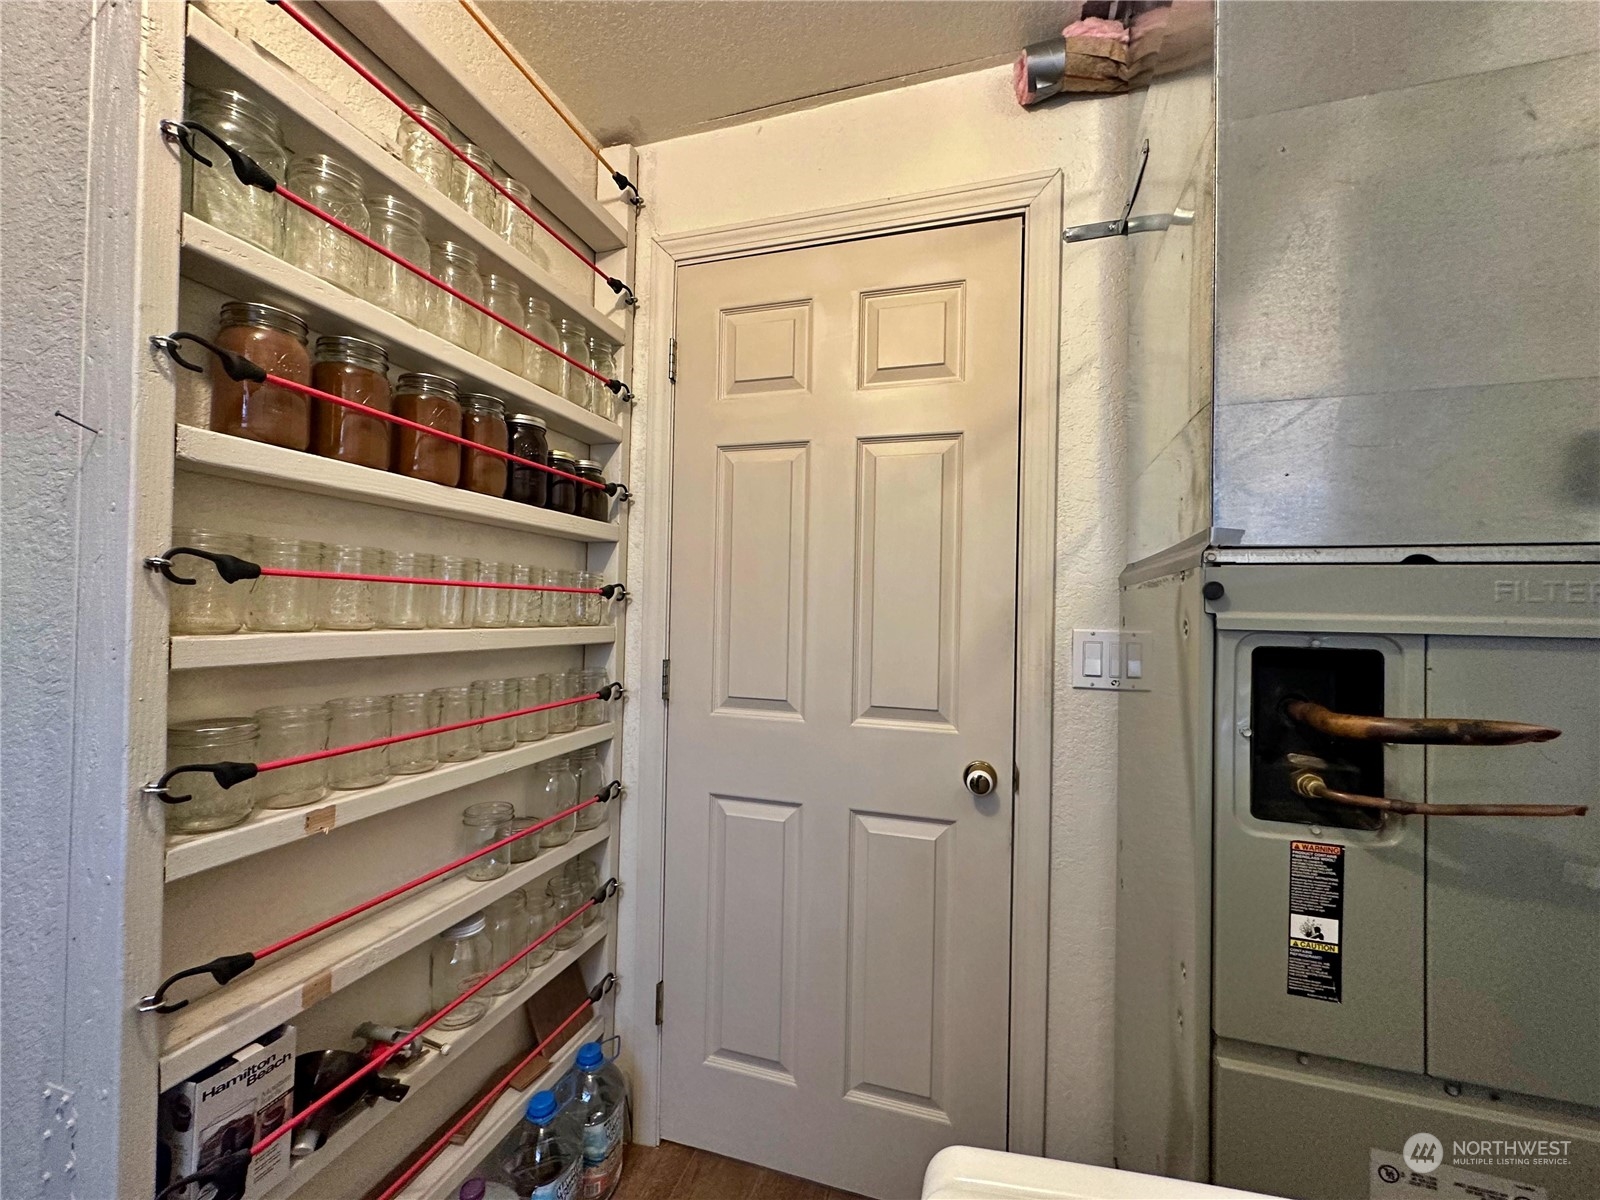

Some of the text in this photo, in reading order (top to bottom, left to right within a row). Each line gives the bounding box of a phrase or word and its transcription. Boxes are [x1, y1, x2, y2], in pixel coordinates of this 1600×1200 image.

[1302, 844, 1339, 854] WARNING
[1300, 941, 1336, 952] CAUTION
[202, 1053, 276, 1102] Hamilton
[246, 1052, 292, 1087] Beach
